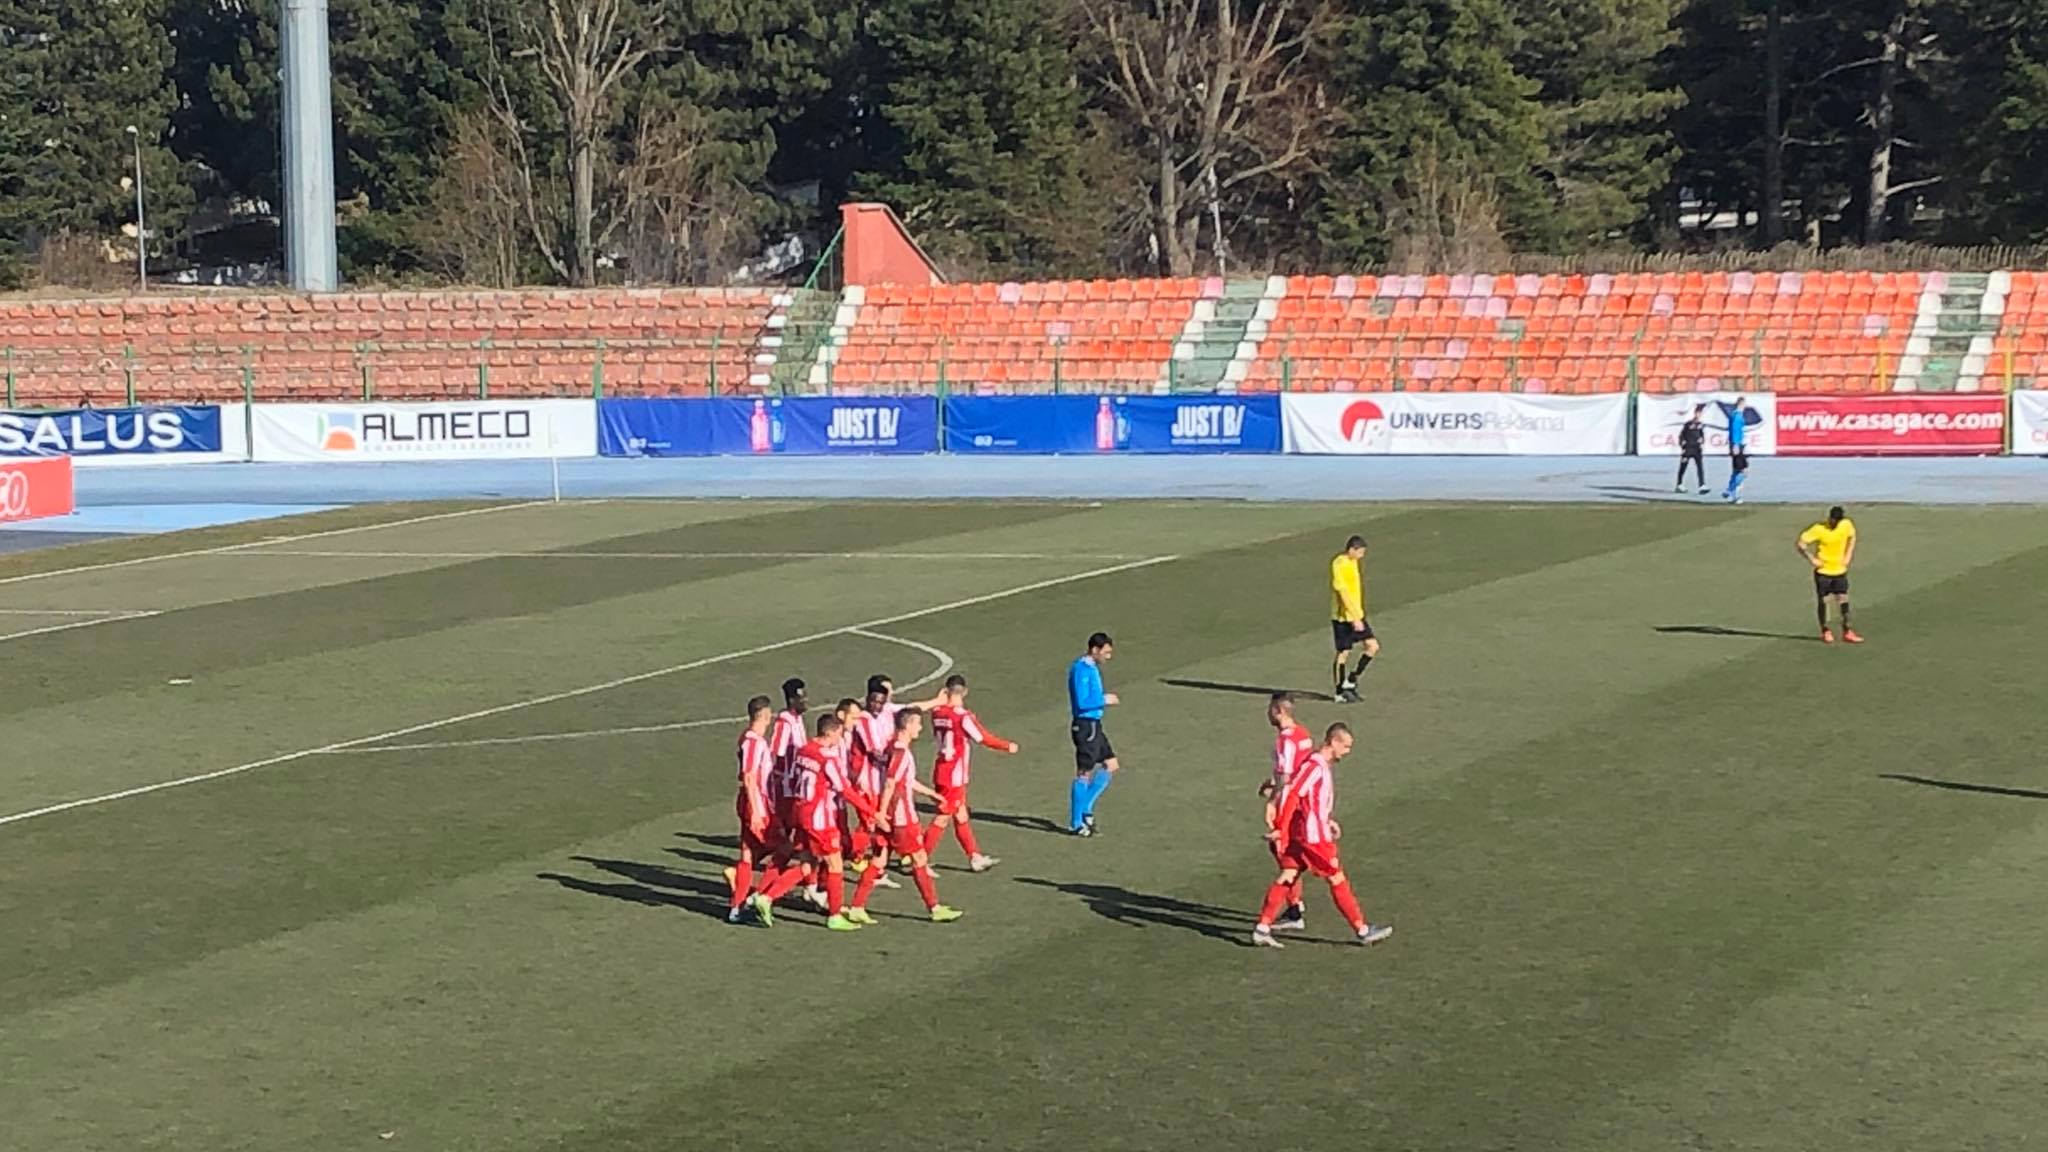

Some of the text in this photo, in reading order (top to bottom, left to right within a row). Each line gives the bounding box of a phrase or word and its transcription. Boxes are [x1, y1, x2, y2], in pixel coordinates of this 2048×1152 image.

[0, 411, 185, 451] SALUS
[362, 410, 530, 441] ALMECO
[827, 407, 877, 438] JUST
[1171, 405, 1221, 437] JUST
[1777, 411, 2004, 435] www.casagace.com
